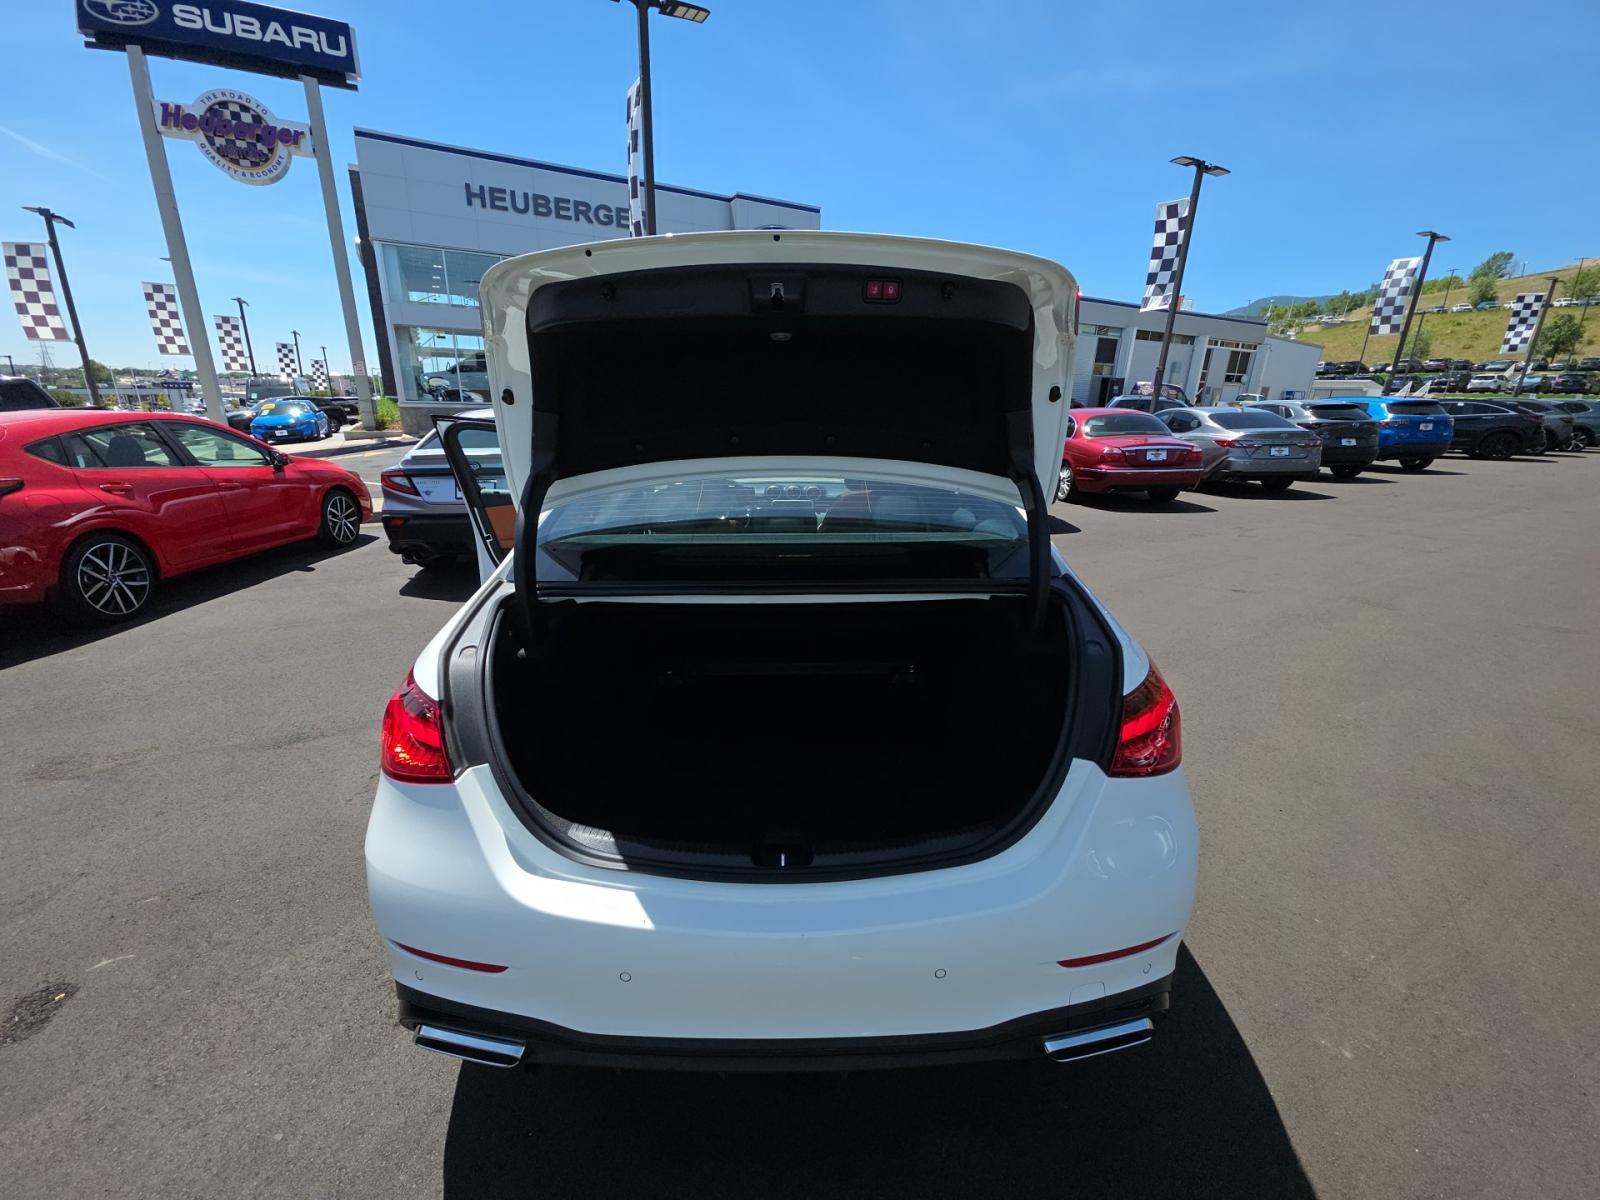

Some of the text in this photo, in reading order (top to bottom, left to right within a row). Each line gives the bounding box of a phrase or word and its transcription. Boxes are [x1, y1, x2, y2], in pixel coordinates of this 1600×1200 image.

[173, 4, 347, 57] SUBARU
[200, 91, 268, 115] THE ROAD TO
[160, 102, 304, 148] Heuberger
[200, 143, 239, 174] QUALITY
[250, 154, 285, 178] ECONOMY
